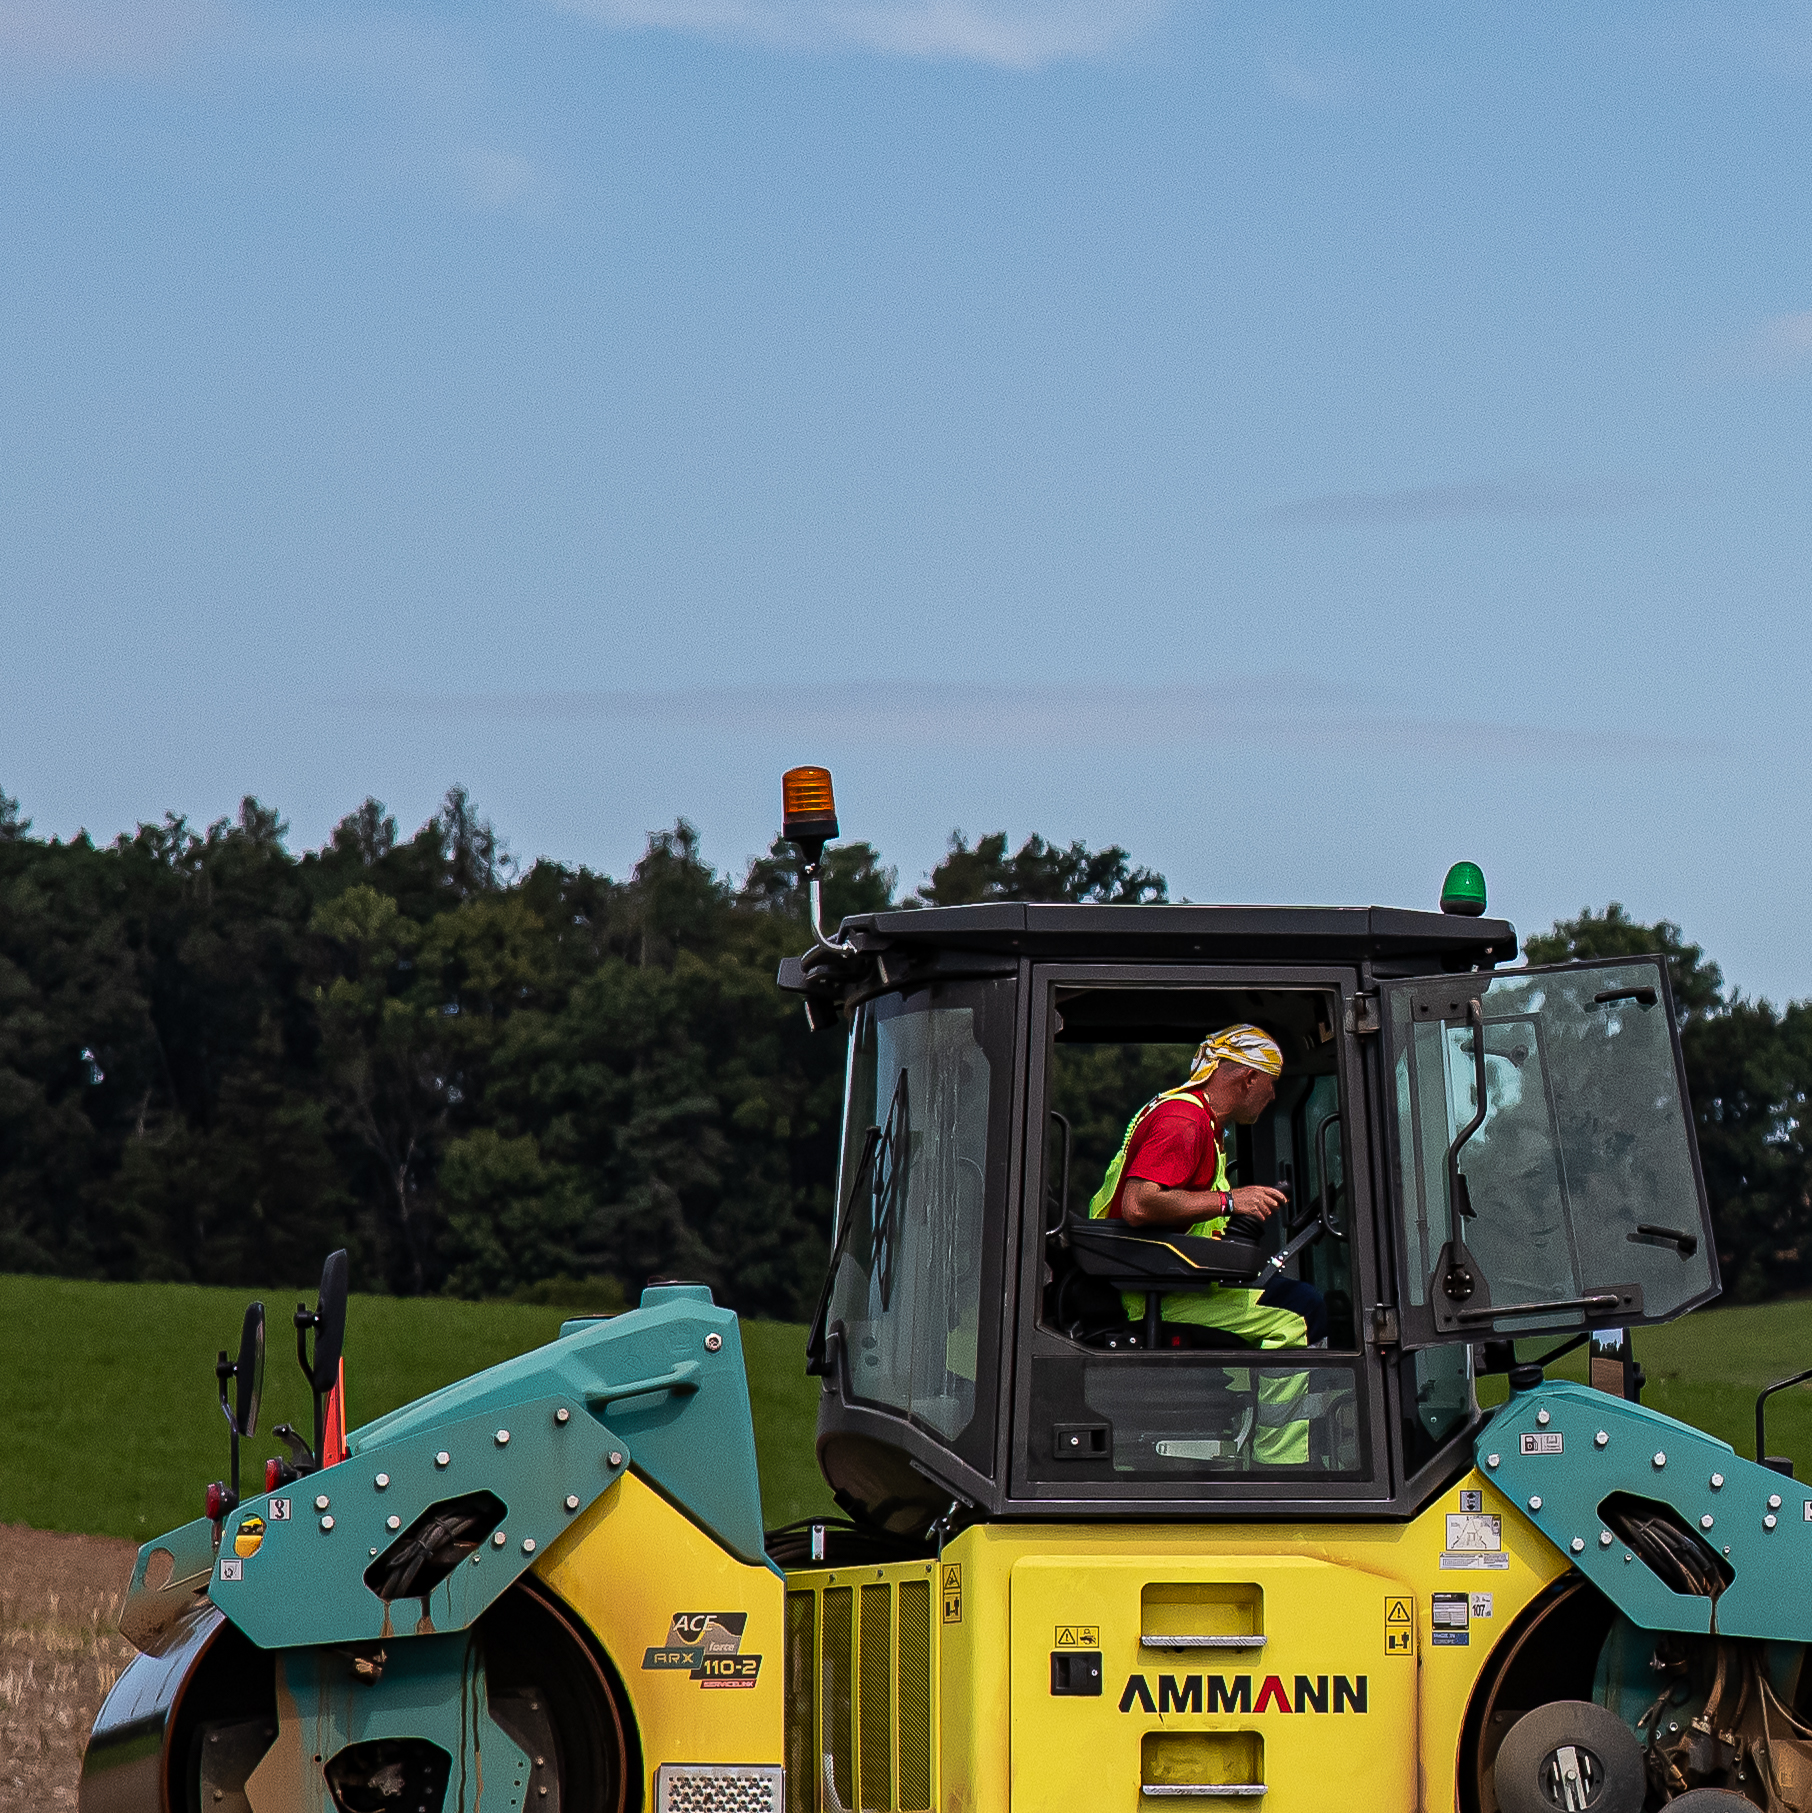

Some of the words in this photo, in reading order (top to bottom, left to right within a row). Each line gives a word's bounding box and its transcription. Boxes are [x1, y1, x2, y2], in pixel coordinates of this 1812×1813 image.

[1472, 1604, 1486, 1617] 107
[673, 1615, 718, 1632] ACE
[709, 1641, 735, 1652] force
[654, 1653, 695, 1664] ARX
[704, 1660, 757, 1675] 110-2
[1118, 1674, 1368, 1713] AMMANN
